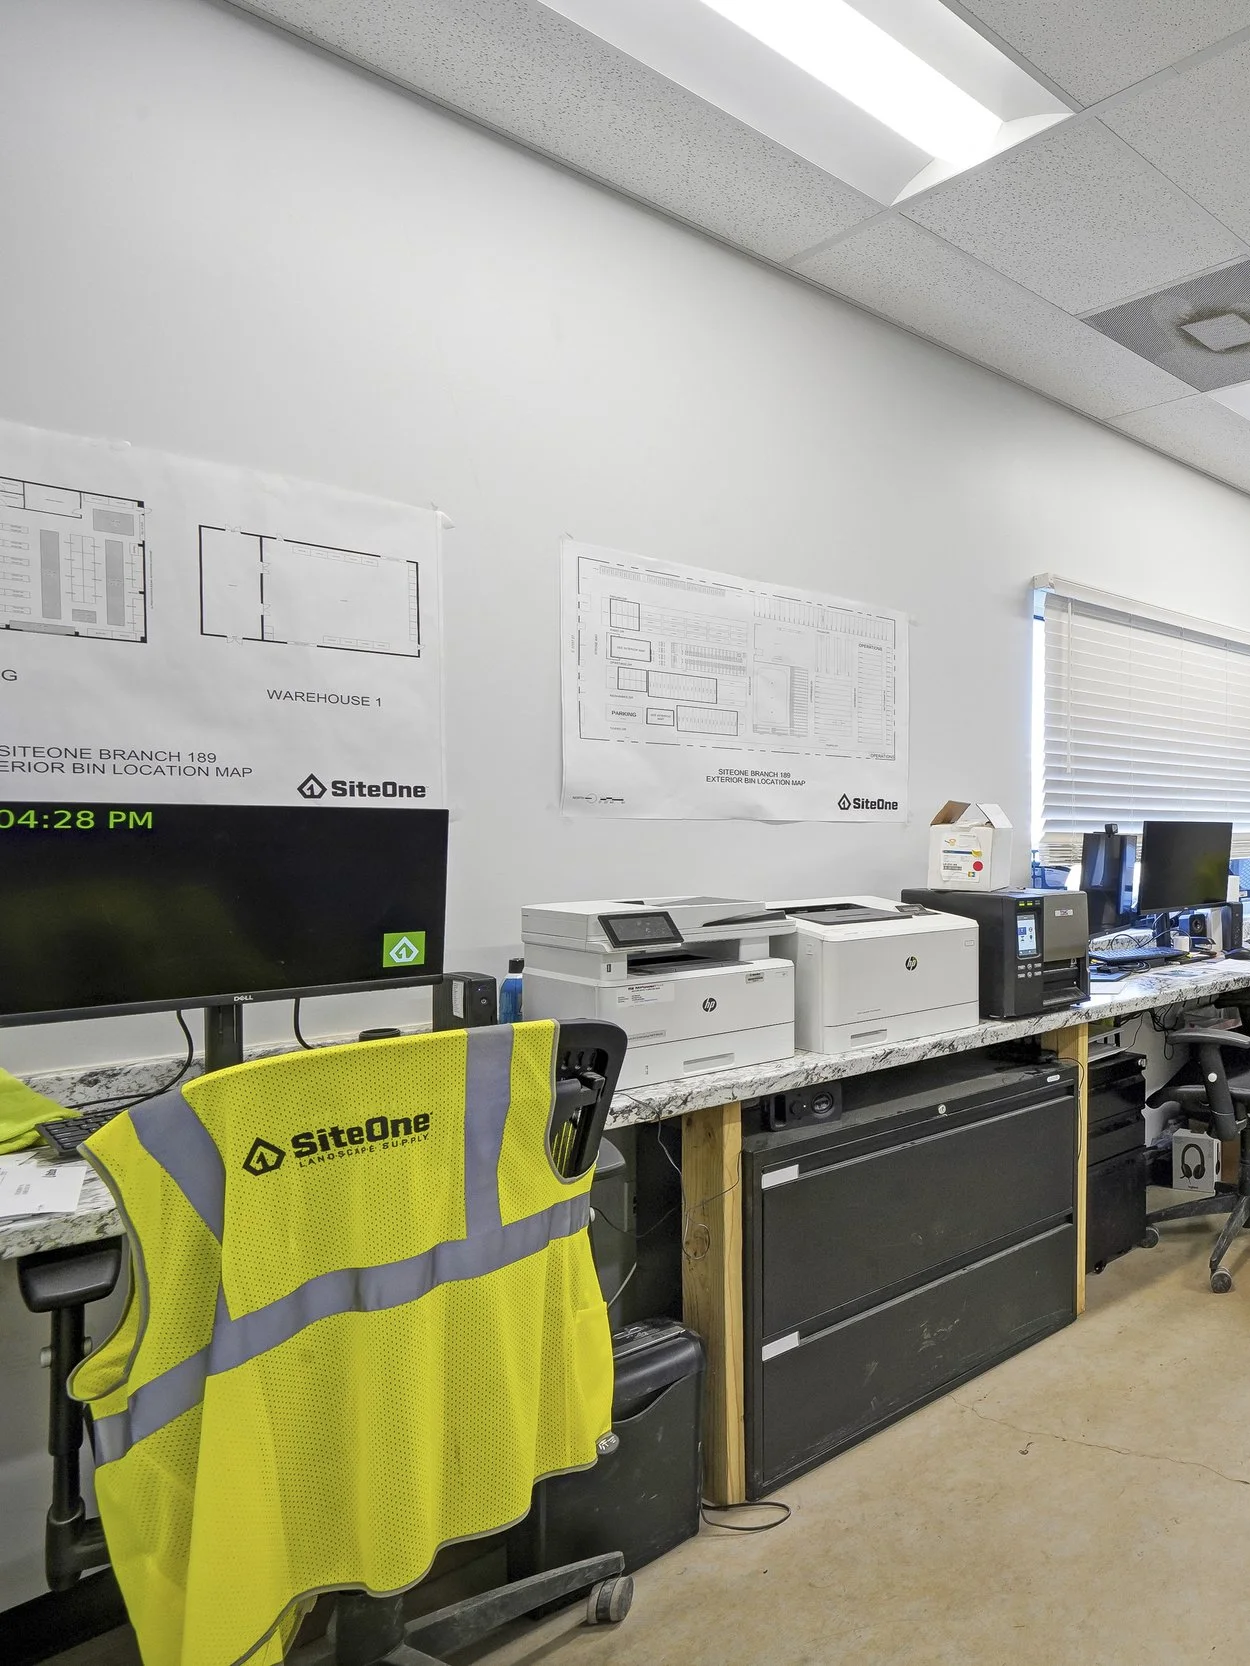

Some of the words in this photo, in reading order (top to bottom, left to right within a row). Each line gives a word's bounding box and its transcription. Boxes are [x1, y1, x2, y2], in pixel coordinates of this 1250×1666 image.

[266, 689, 371, 707] WAREHOUSE
[375, 697, 382, 707] 1
[611, 710, 637, 718] PARKING
[0, 745, 92, 760] SITEONE
[99, 748, 181, 762] BRANCH
[188, 752, 217, 764] 189
[72, 762, 106, 775] BIN
[112, 764, 210, 777] LOCATION
[215, 766, 253, 778] MAP
[718, 768, 749, 776] SITEONE
[750, 770, 779, 778] BRANCH
[706, 775, 743, 783] EXTERIOR
[757, 778, 790, 786] LOCATION
[331, 780, 427, 798] SiteOne
[852, 797, 898, 810] SiteOne
[0, 809, 95, 829] 04:28
[108, 811, 153, 829] PM
[233, 994, 254, 1002] DELL
[702, 997, 717, 1012] hp
[290, 1112, 432, 1159] SiteOne
[299, 1144, 376, 1168] LANDSCAPE
[382, 1132, 430, 1150] SUPPLY
